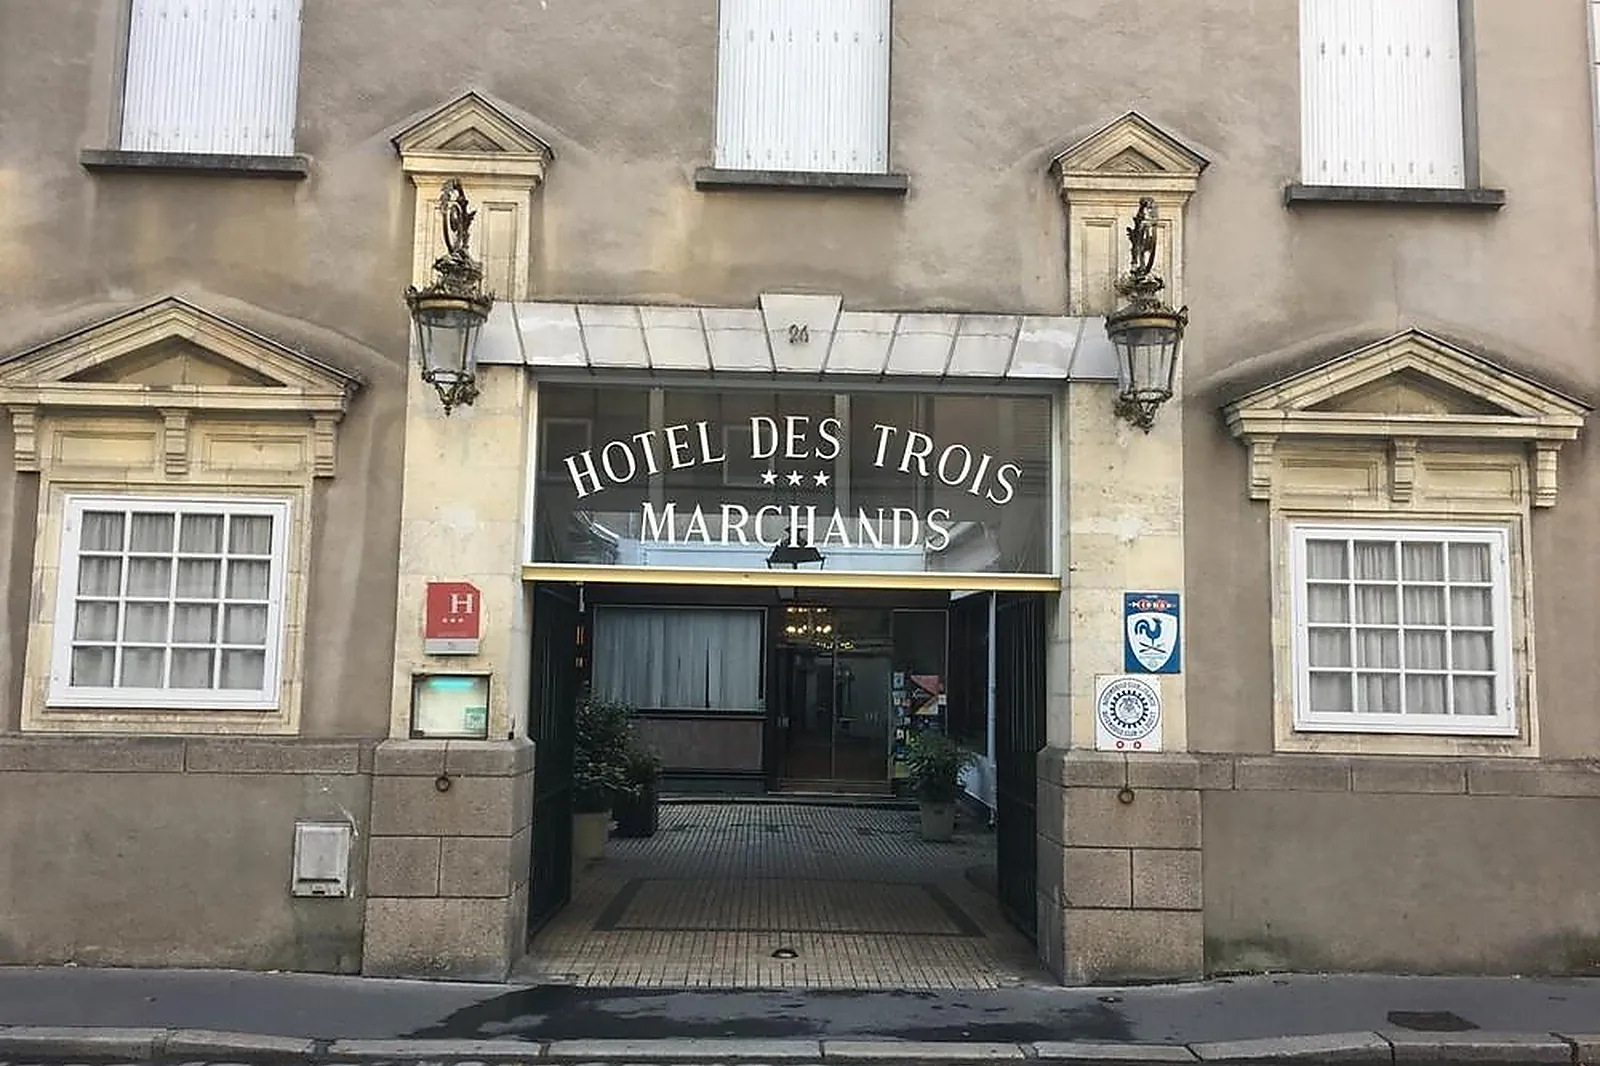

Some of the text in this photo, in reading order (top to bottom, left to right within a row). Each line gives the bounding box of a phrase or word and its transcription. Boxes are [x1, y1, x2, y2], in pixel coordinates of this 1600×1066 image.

[789, 323, 809, 343] 26
[563, 415, 1022, 504] HOTEL DES TROIS
[640, 502, 951, 551] MARCHANDS
[451, 593, 474, 614] H
